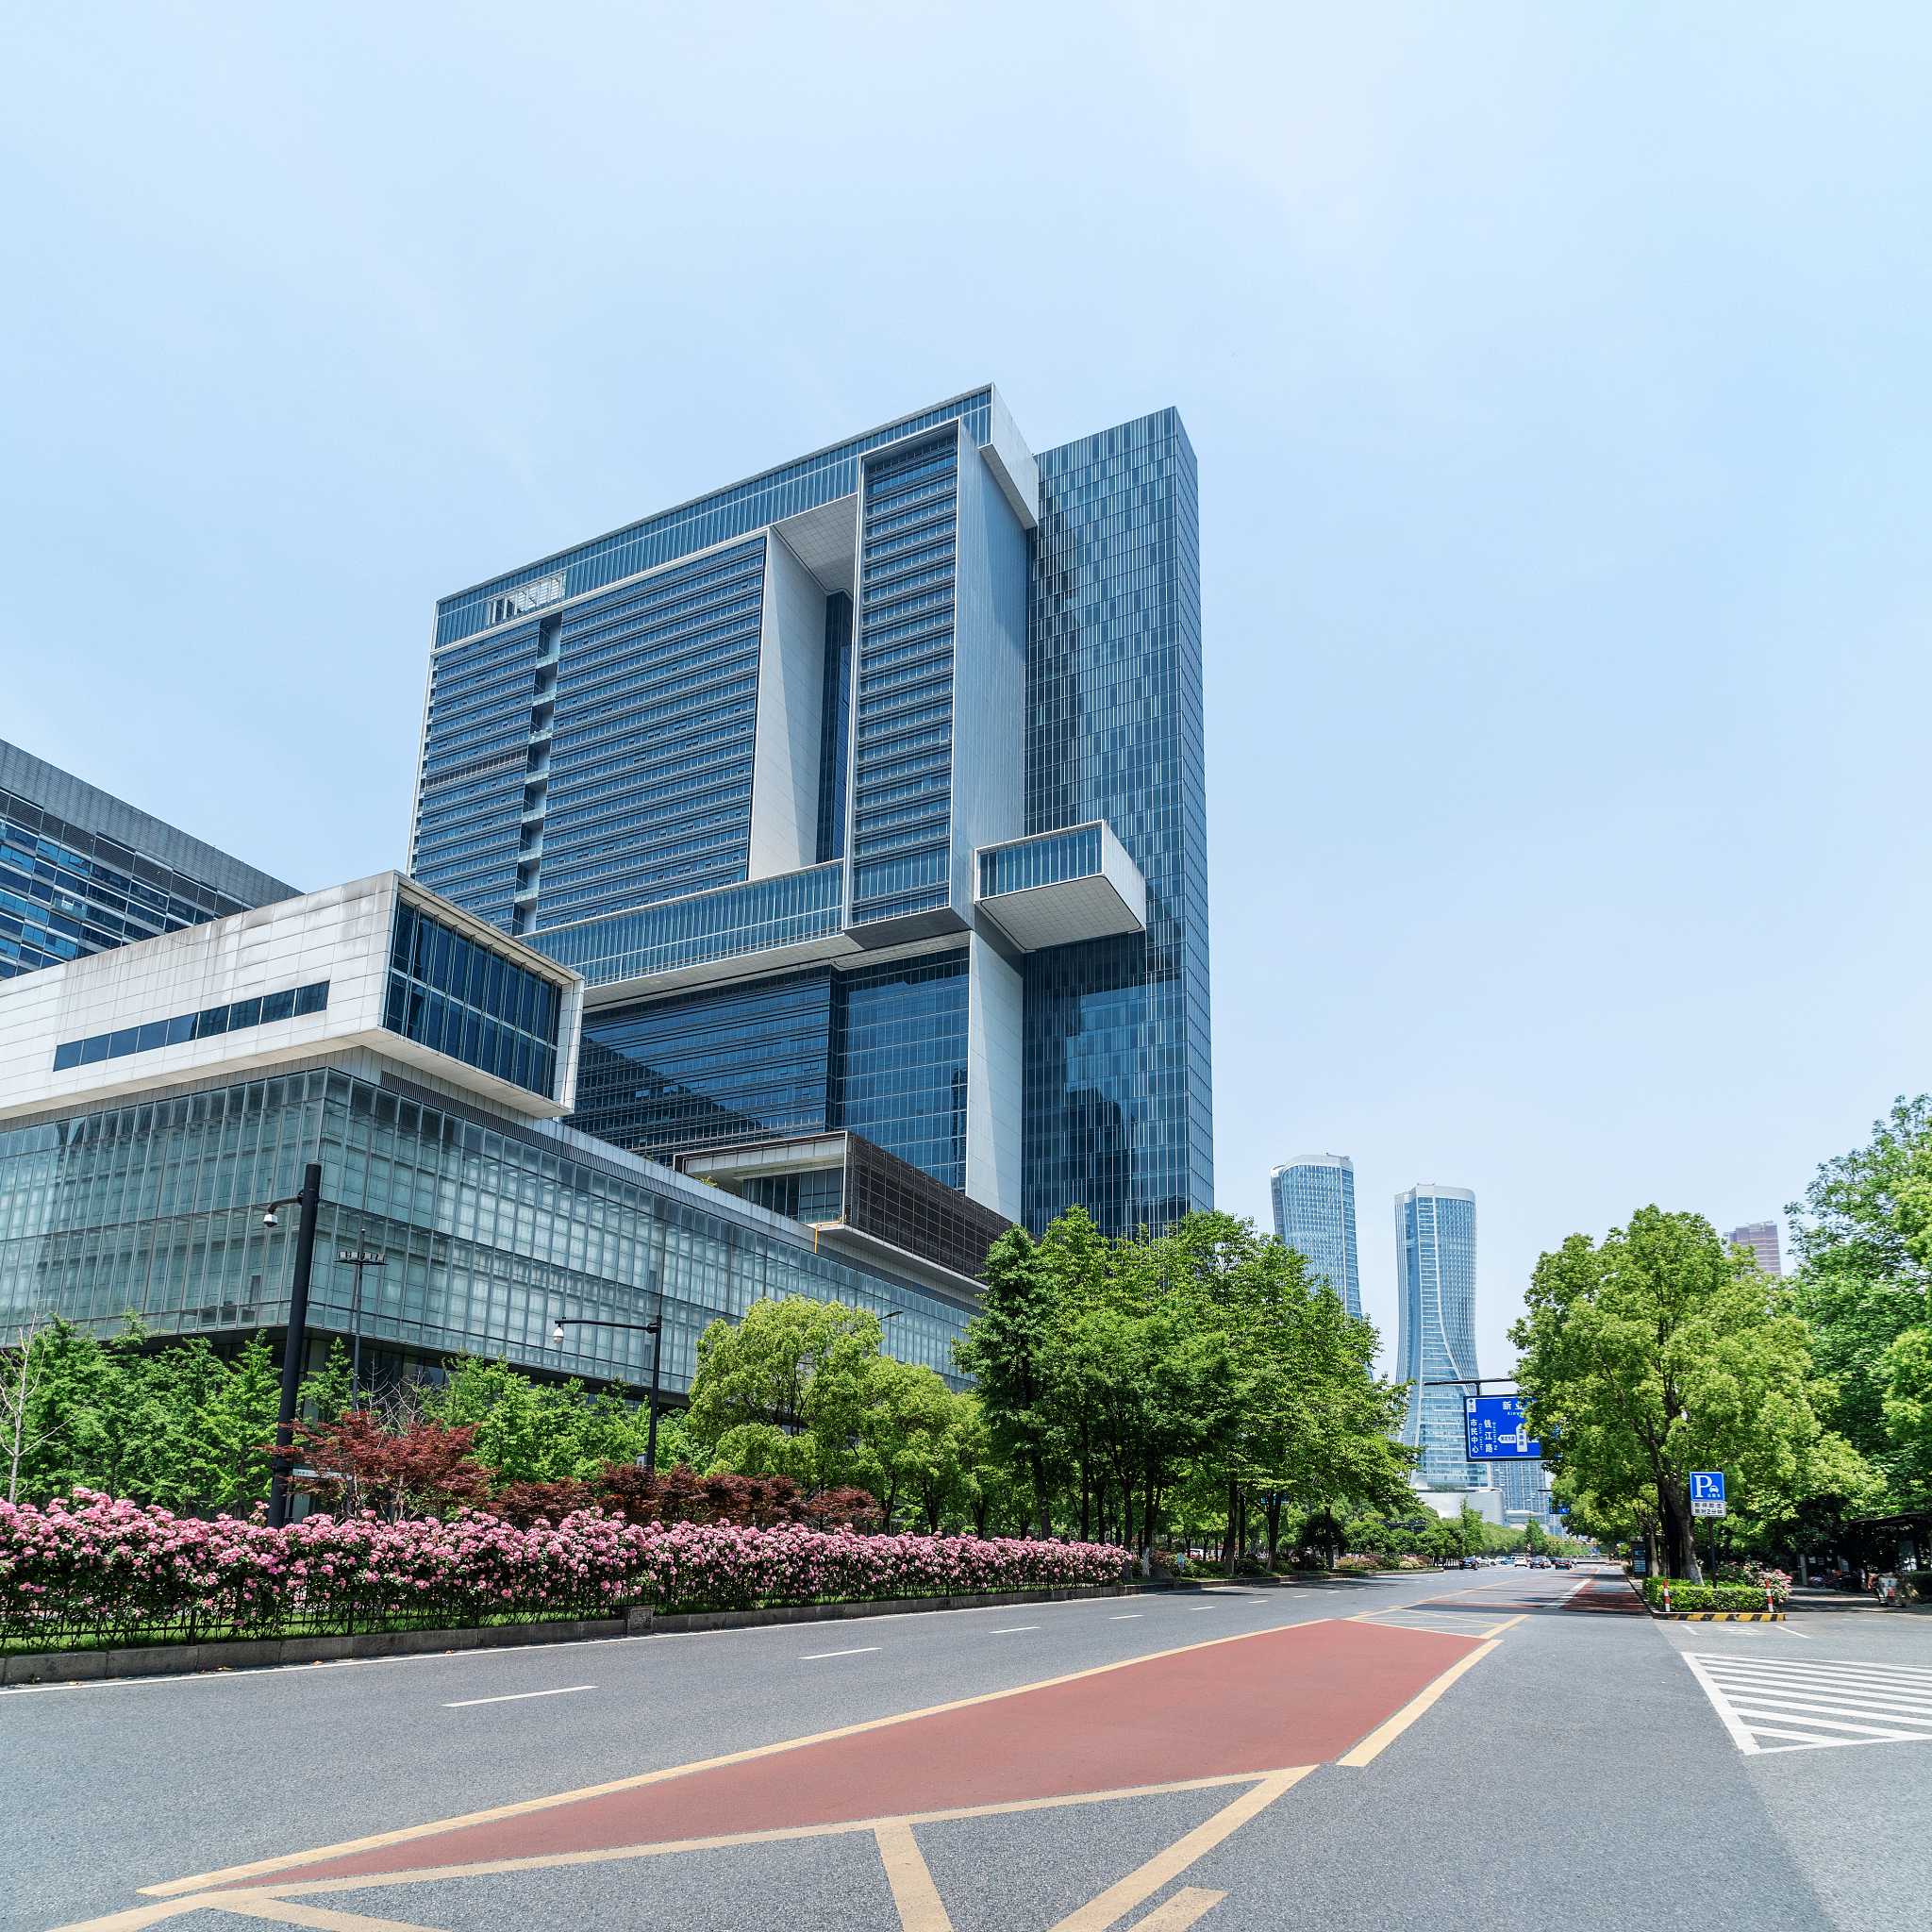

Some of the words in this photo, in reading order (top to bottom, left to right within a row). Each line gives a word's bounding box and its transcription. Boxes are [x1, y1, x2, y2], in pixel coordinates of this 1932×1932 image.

[1470, 1419, 1479, 1453] 市民中心
[1484, 1419, 1493, 1453] 钱江路
[1694, 1474, 1712, 1498] P
